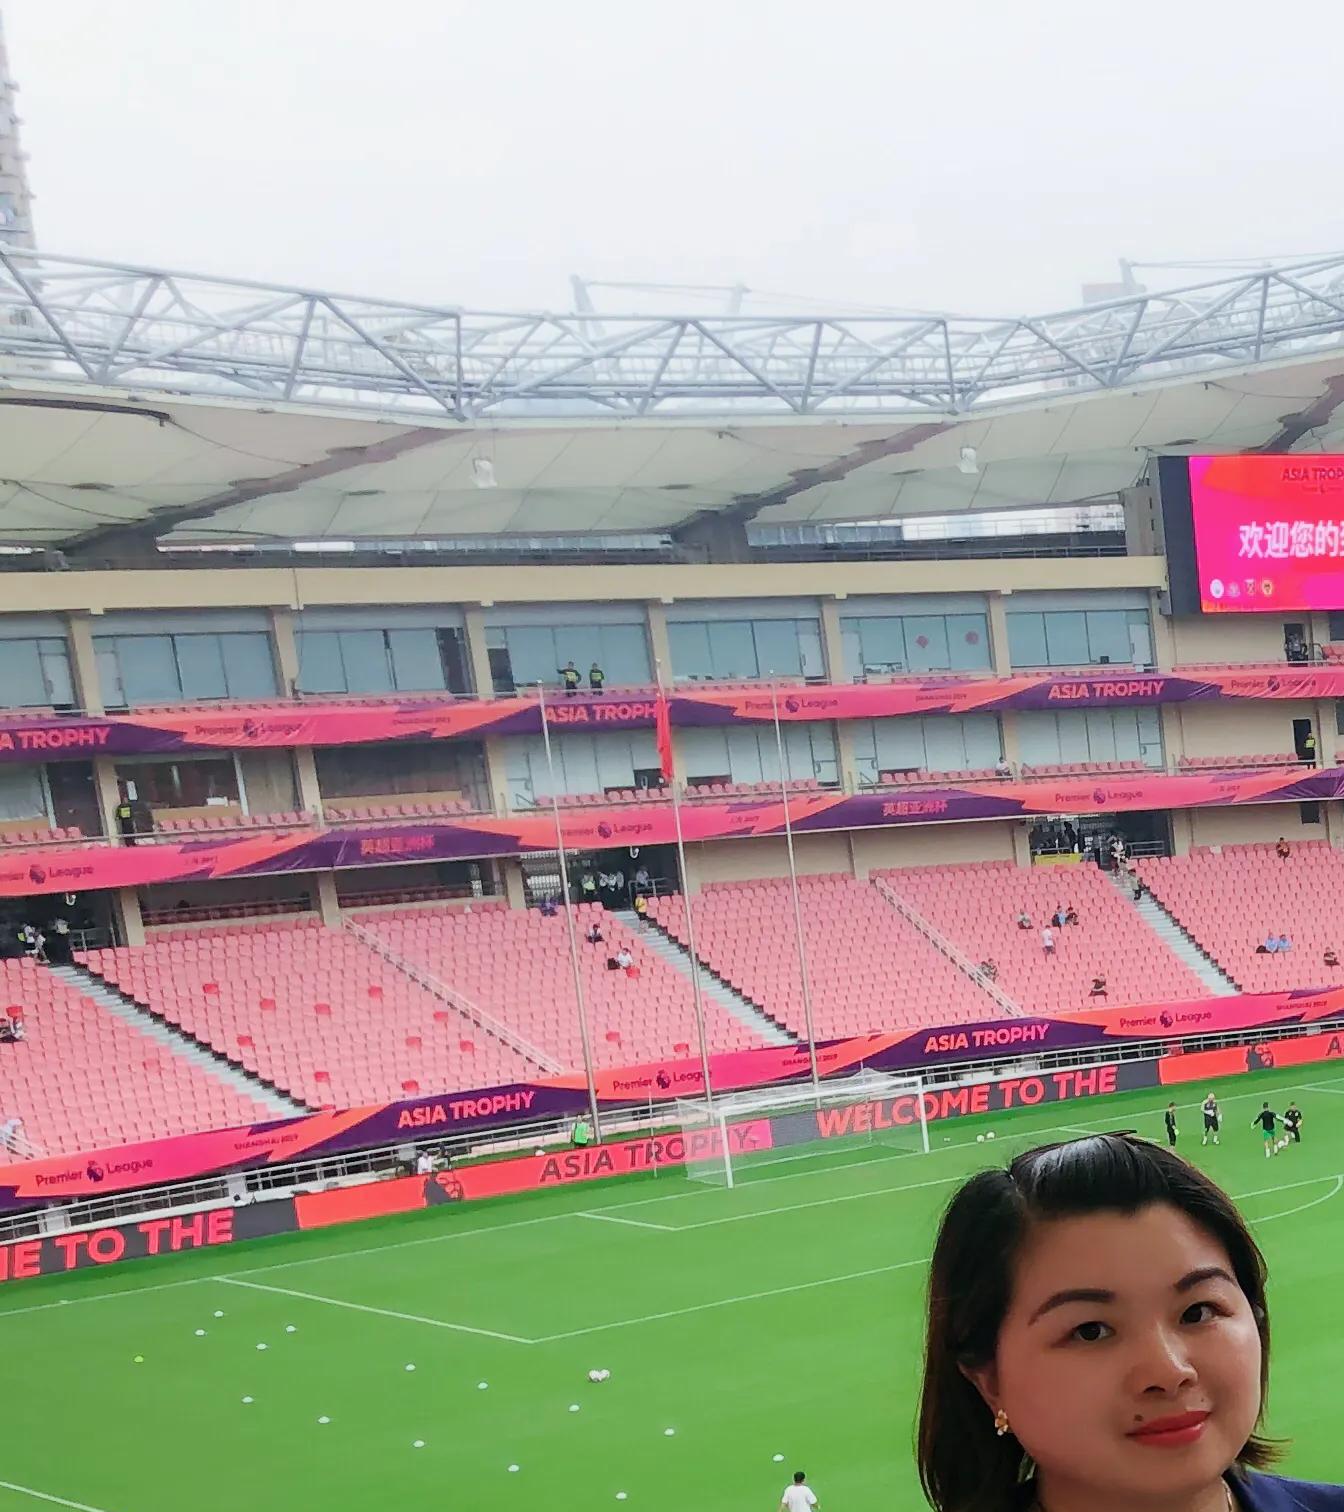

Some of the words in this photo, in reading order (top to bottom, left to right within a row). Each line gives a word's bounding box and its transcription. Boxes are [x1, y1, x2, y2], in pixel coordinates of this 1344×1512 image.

[1283, 468, 1308, 481] ASIA
[1048, 682, 1089, 700] ASIA
[1093, 680, 1166, 698] TROPHY
[546, 706, 589, 723] ASIA
[18, 727, 110, 749] TROPHY
[1055, 794, 1090, 804] Premier
[1107, 790, 1143, 801] League
[1120, 1015, 1157, 1029] Premier
[1175, 1010, 1212, 1023] League
[925, 1031, 968, 1054] ASIA
[972, 1023, 1049, 1048] TROPHY
[613, 1076, 652, 1090] Premier
[398, 1105, 447, 1129] ASIA
[450, 1091, 534, 1118] TROPHY
[815, 1085, 990, 1138] WELCOME
[999, 1077, 1045, 1108] TO
[1053, 1065, 1120, 1100] THE
[35, 1169, 82, 1188] Premier
[107, 1158, 153, 1176] League
[540, 1148, 614, 1183] ASIA
[56, 1228, 125, 1271] TO
[138, 1207, 234, 1256] THE
